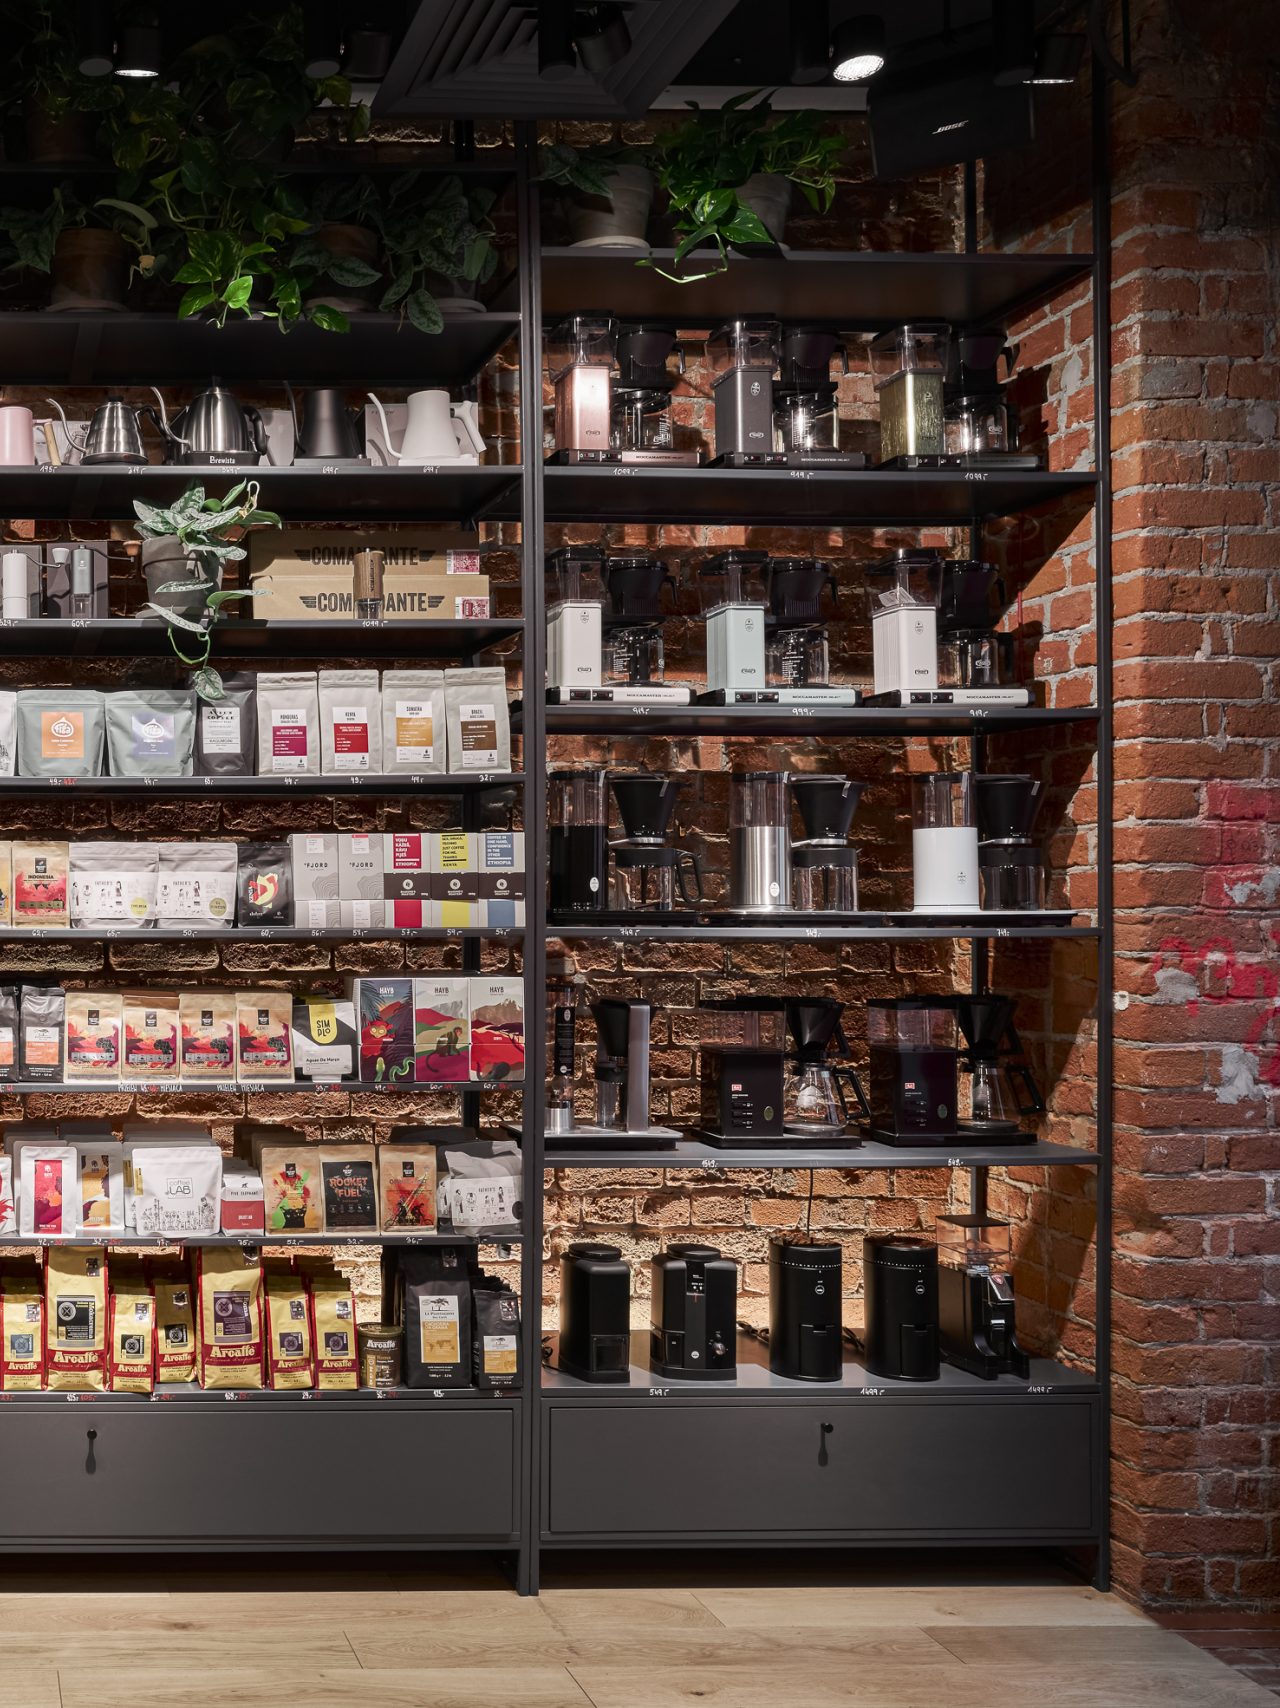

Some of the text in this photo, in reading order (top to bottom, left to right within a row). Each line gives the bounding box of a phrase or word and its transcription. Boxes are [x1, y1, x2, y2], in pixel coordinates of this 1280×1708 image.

[209, 456, 236, 464] Brewista
[317, 592, 427, 612] COMANTE
[329, 1176, 368, 1188] ROCKET
[337, 1188, 362, 1198] FUEL
[53, 1351, 99, 1364] Arcaffè
[210, 1346, 256, 1358] Arcaffè
